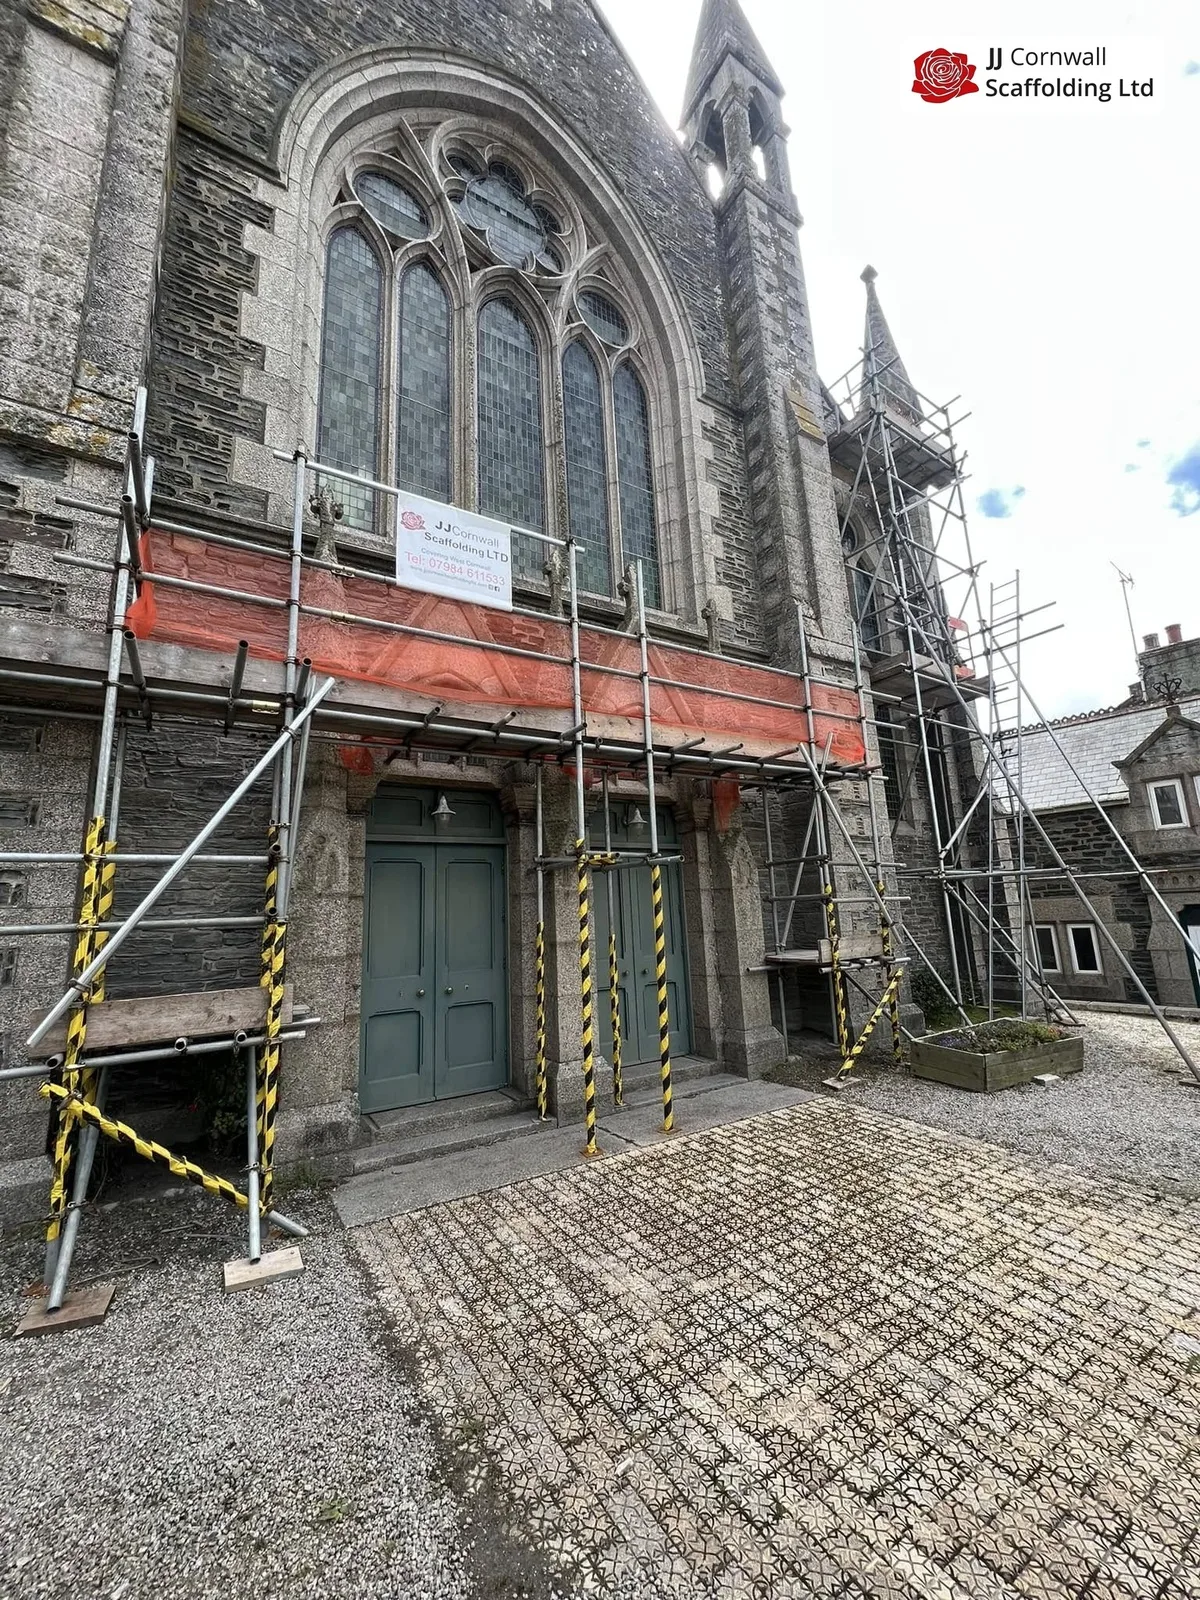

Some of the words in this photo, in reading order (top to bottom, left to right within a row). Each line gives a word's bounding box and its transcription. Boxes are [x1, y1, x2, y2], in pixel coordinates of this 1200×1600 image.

[424, 532, 485, 558] Scaffolding
[487, 550, 509, 563] LTD
[404, 551, 425, 566] Tel:
[429, 558, 463, 574] 07984
[467, 569, 506, 586] 611533
